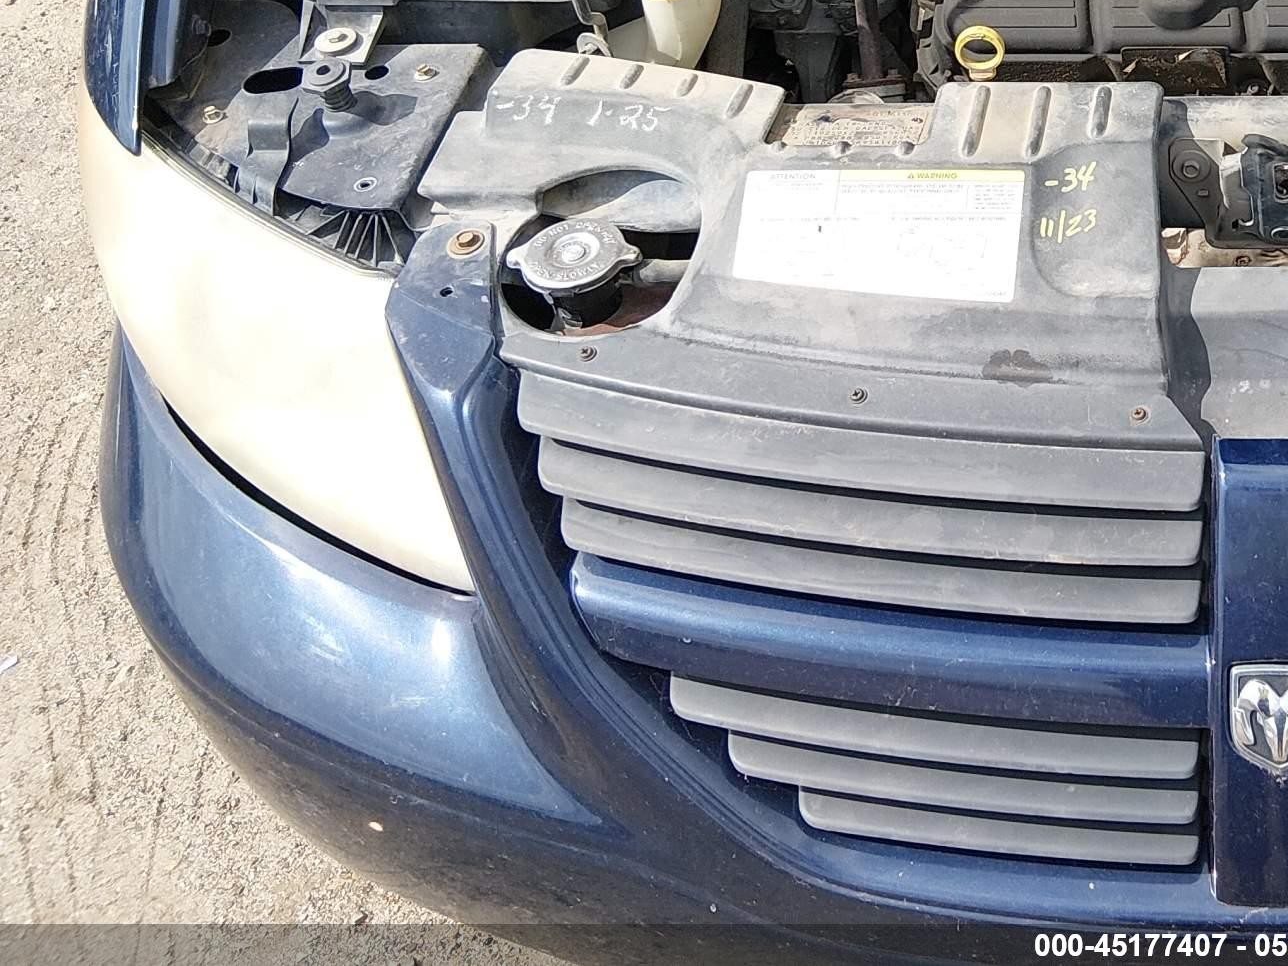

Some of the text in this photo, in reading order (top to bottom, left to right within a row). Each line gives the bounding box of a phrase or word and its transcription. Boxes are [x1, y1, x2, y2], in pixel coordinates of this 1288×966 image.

[916, 172, 958, 180] WARNING
[1044, 161, 1097, 192] -34
[1040, 209, 1097, 243] 11/23
